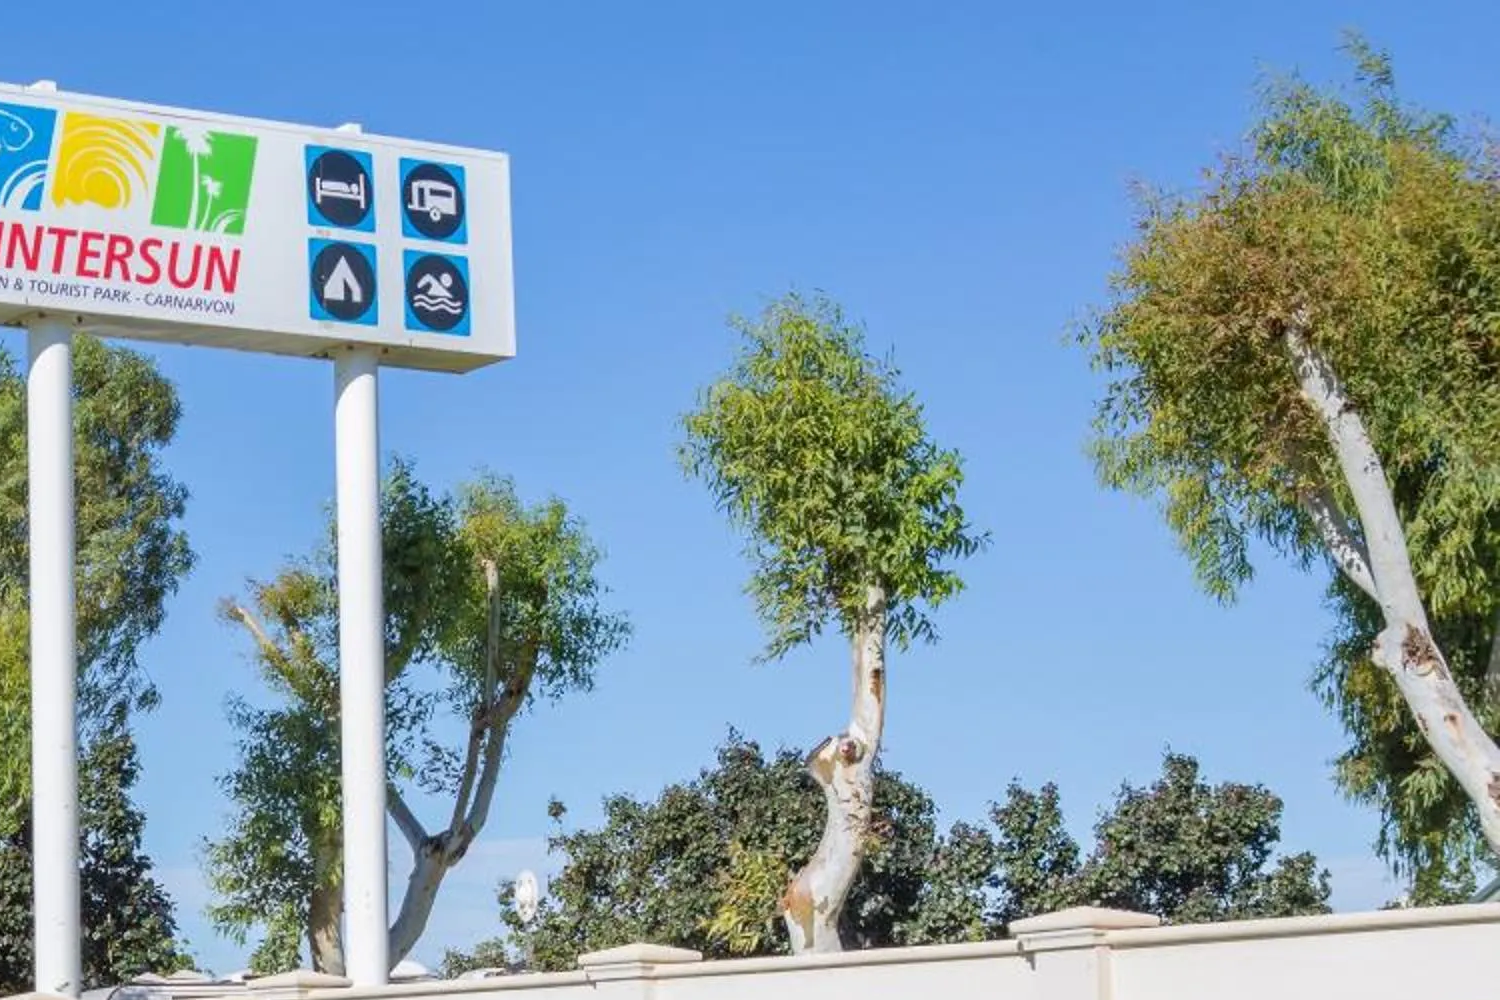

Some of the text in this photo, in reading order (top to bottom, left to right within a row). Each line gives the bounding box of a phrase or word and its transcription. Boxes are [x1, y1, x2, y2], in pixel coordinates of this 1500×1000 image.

[13, 277, 24, 290] &
[29, 280, 88, 298] TOURIST
[93, 287, 132, 303] PARK
[143, 292, 236, 315] CARNARVON
